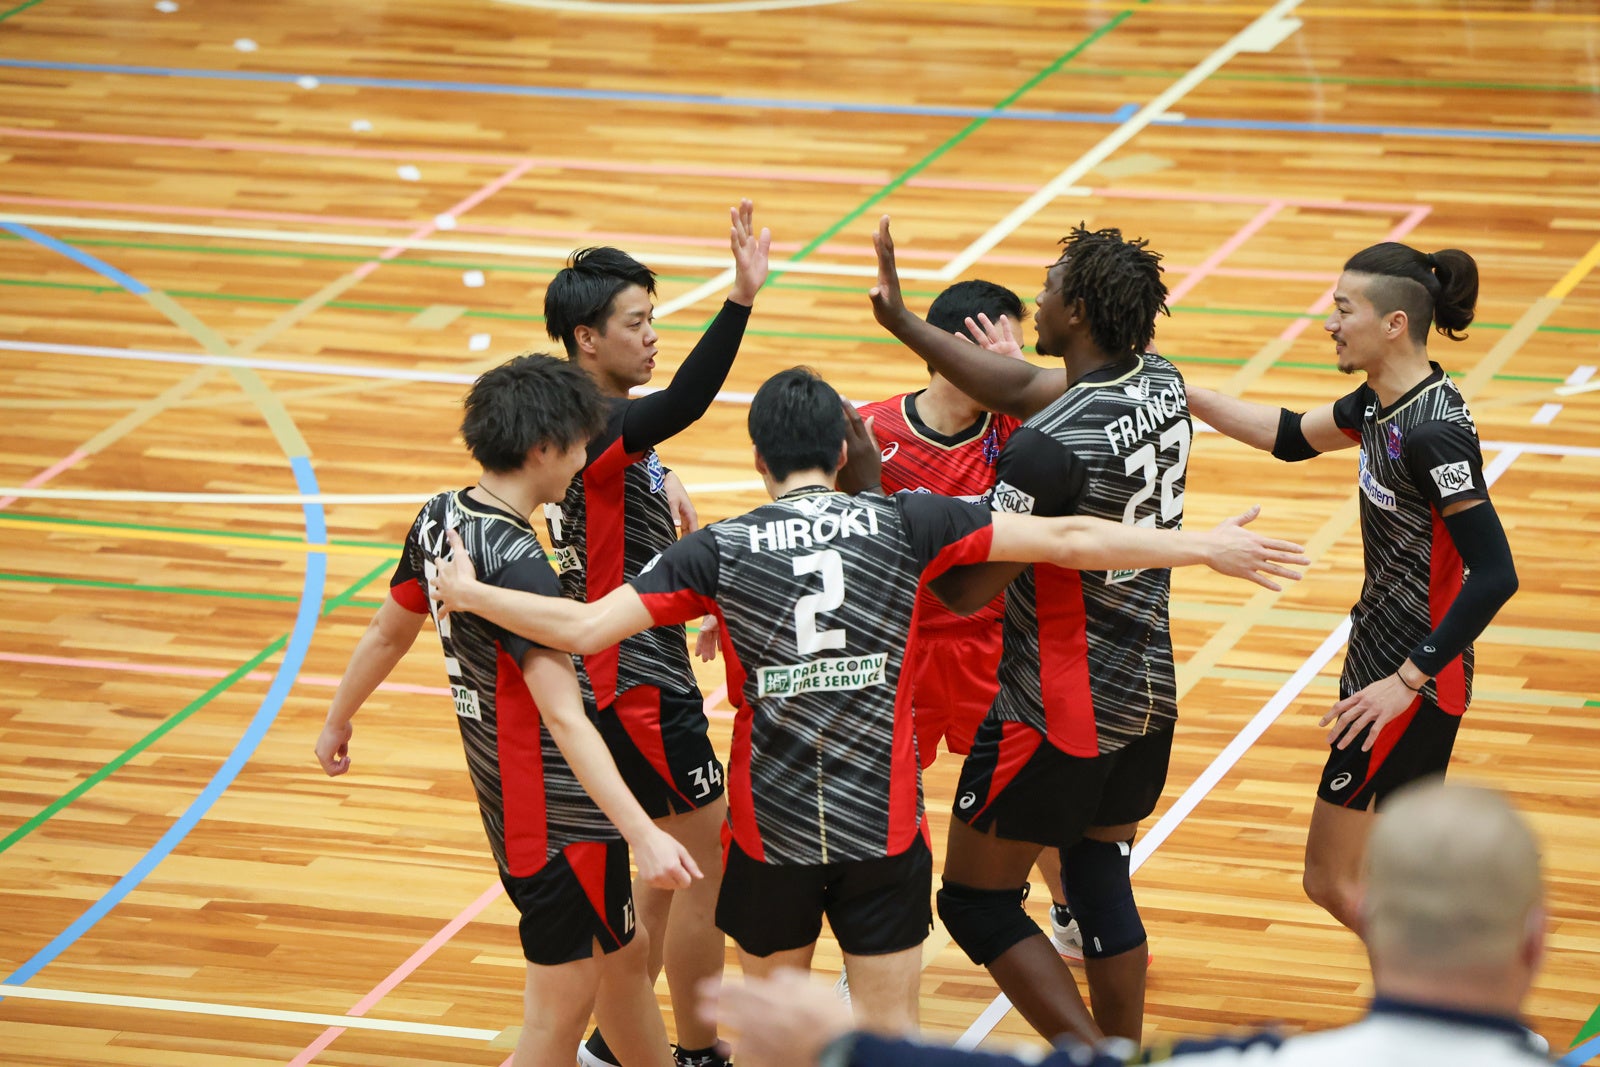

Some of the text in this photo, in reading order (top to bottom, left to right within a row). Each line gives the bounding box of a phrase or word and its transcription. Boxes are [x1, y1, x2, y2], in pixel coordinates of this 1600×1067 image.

[1122, 419, 1191, 526] 22
[750, 508, 879, 553] HIROKI
[792, 549, 846, 656] 2
[825, 671, 880, 687] SERVICE
[688, 760, 722, 799] 34
